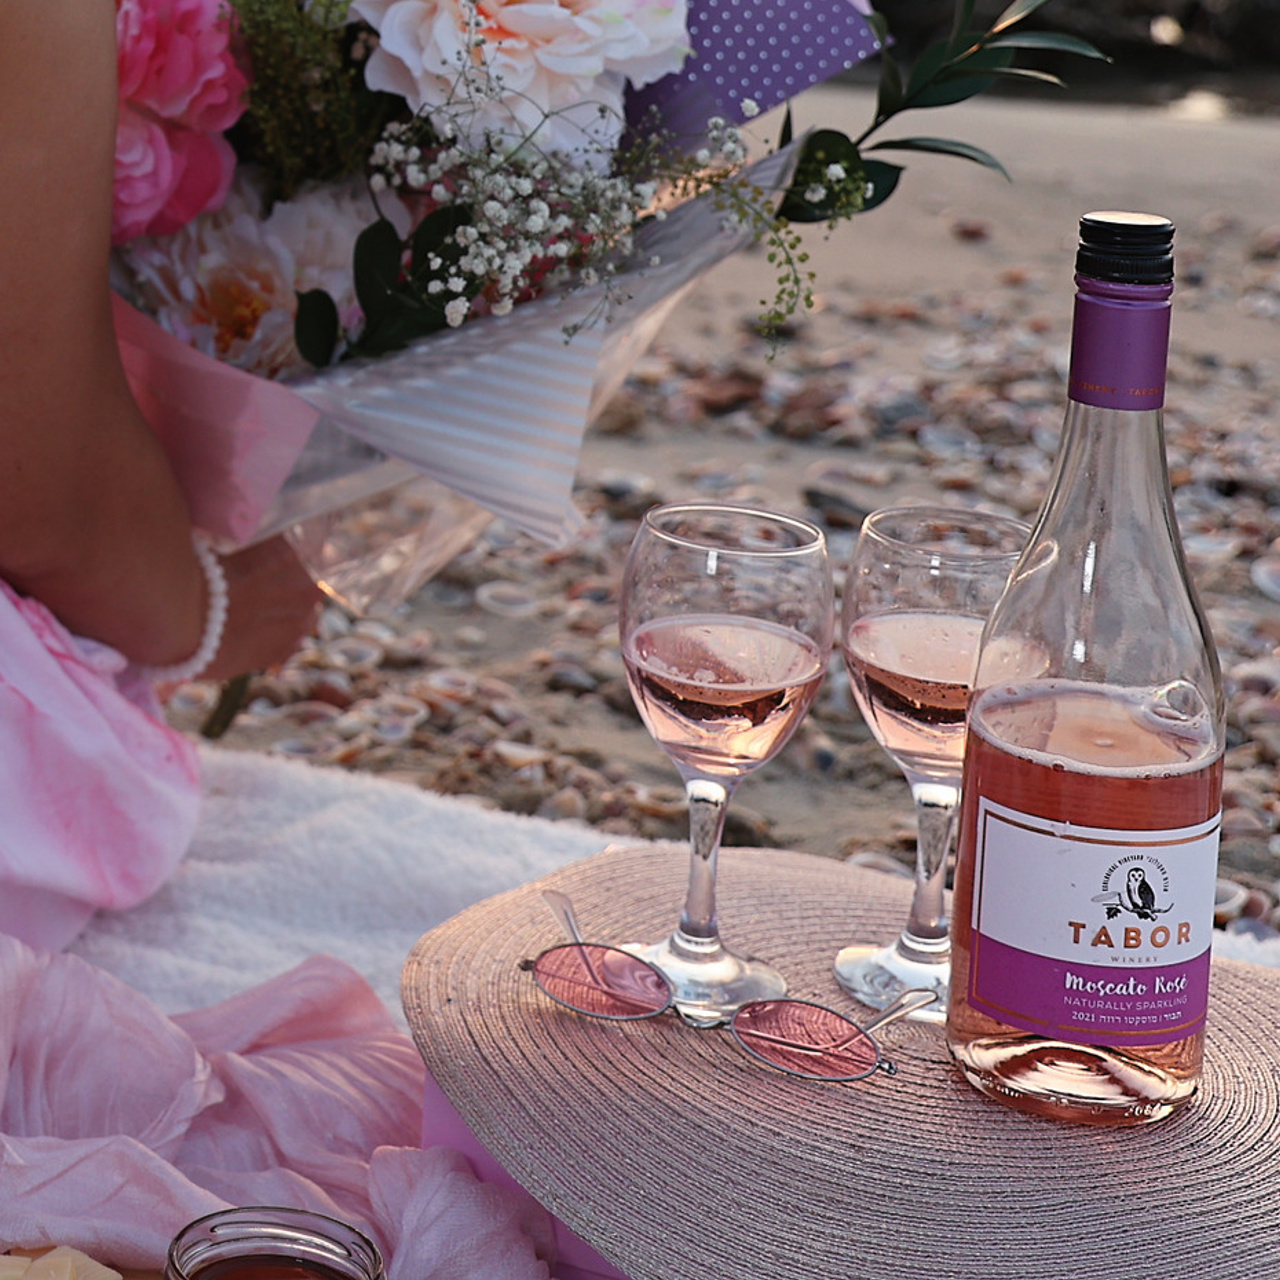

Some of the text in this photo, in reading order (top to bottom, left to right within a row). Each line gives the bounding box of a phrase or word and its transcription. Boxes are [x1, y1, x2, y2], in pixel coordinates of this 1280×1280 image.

[1068, 921, 1191, 949] TABOR
[1065, 971, 1188, 997] Moscato Rosé
[1063, 995, 1188, 1011] NATURALLY SPARKLING
[1071, 1011, 1096, 1022] 2021
